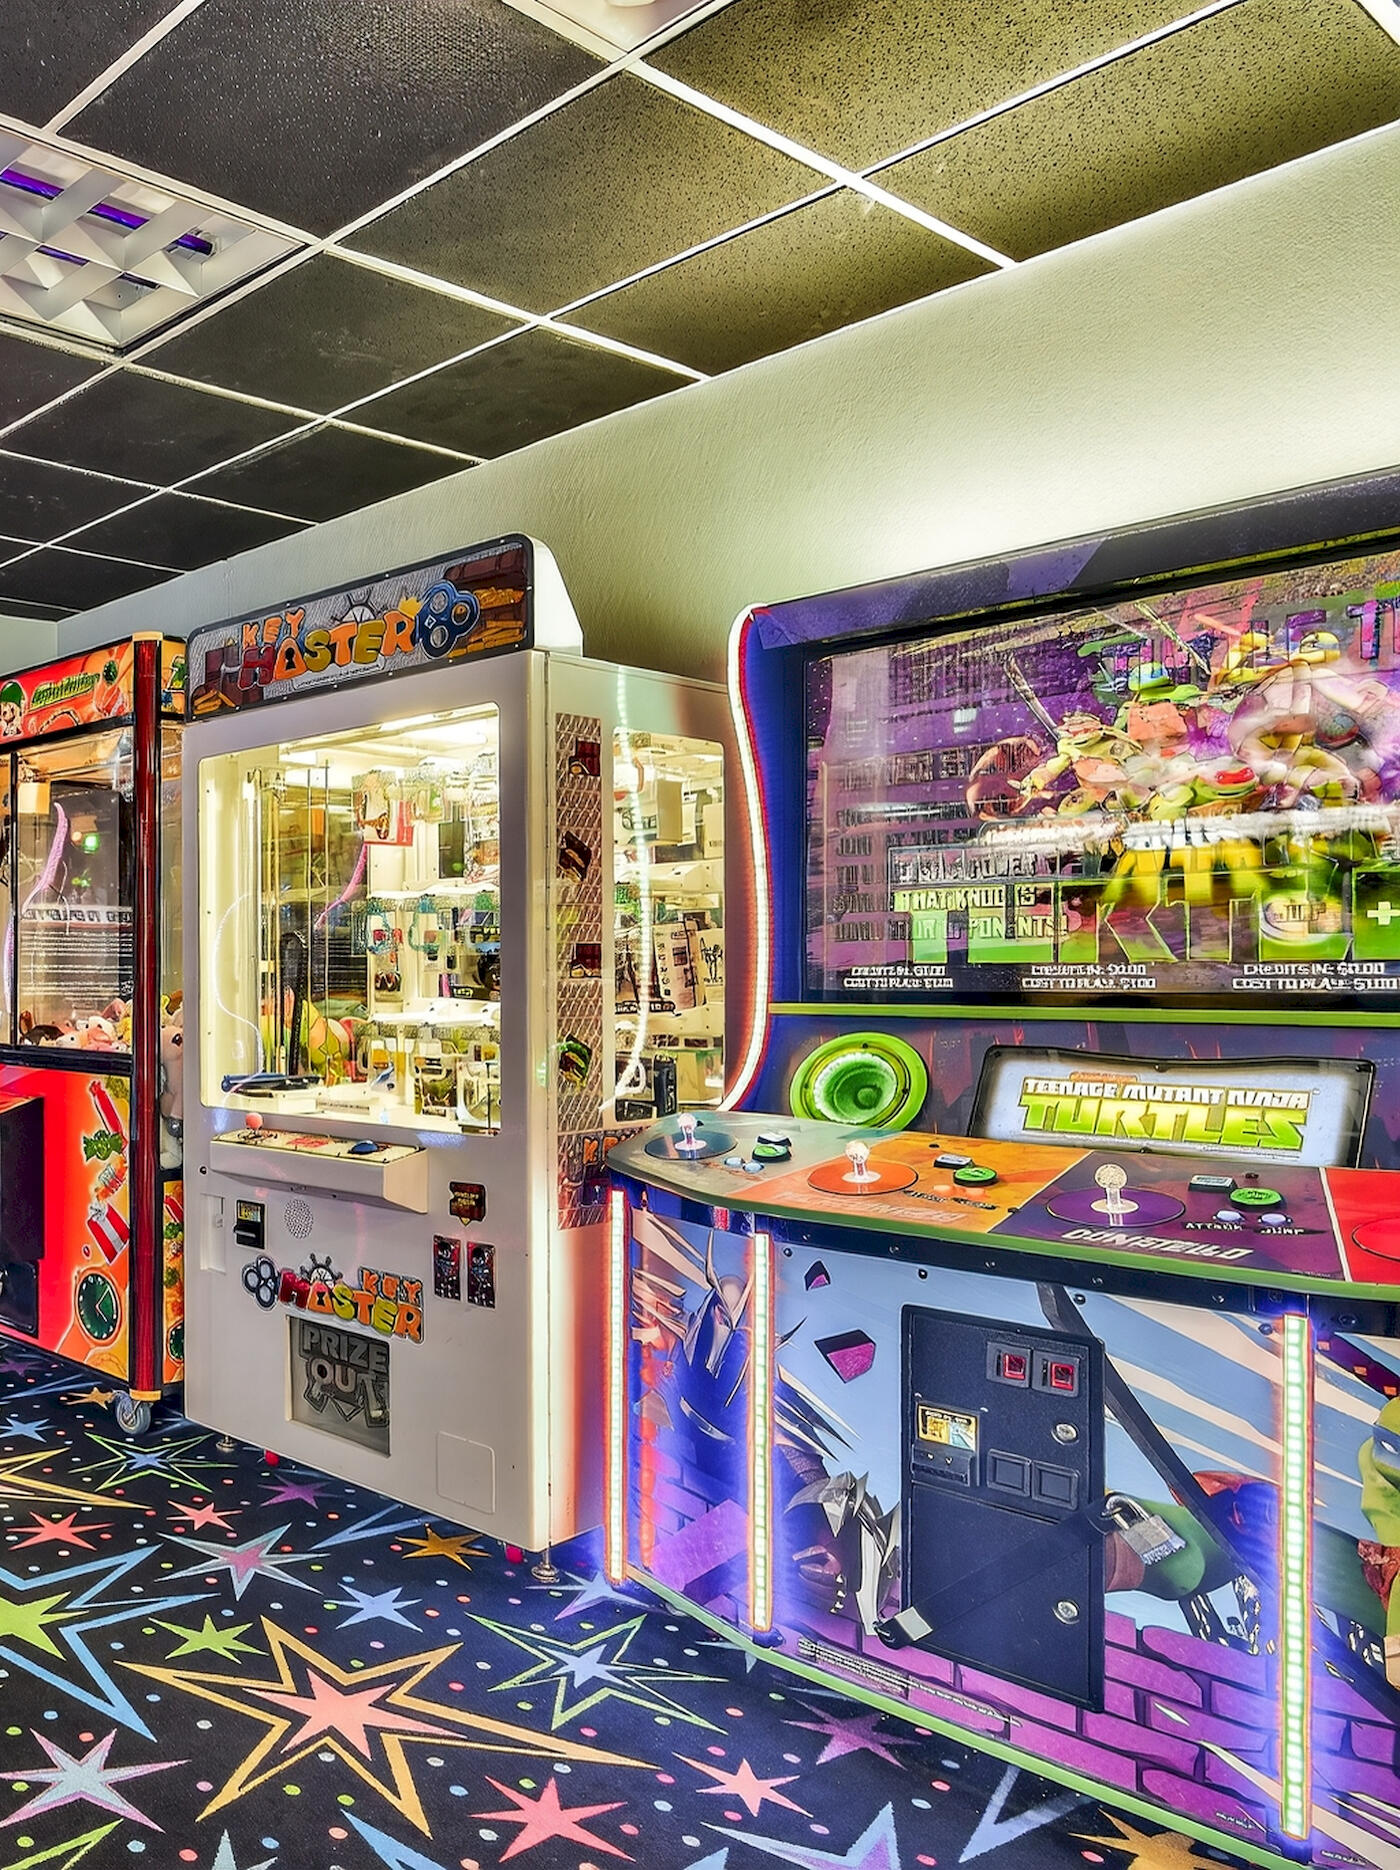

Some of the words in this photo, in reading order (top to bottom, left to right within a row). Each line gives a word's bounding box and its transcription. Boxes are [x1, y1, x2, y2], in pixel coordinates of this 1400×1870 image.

[237, 609, 416, 691] MASTER
[241, 607, 305, 648] KEY
[1023, 1078, 1118, 1099] TEENAGE
[1121, 1082, 1226, 1105] MUTANT
[1226, 1088, 1311, 1109] NINJA
[1019, 1094, 1309, 1150] TURTLES
[278, 1270, 423, 1344] MASTER
[361, 1268, 422, 1304] KEY
[302, 1322, 389, 1373] PRIZE
[310, 1357, 387, 1420] OUT
